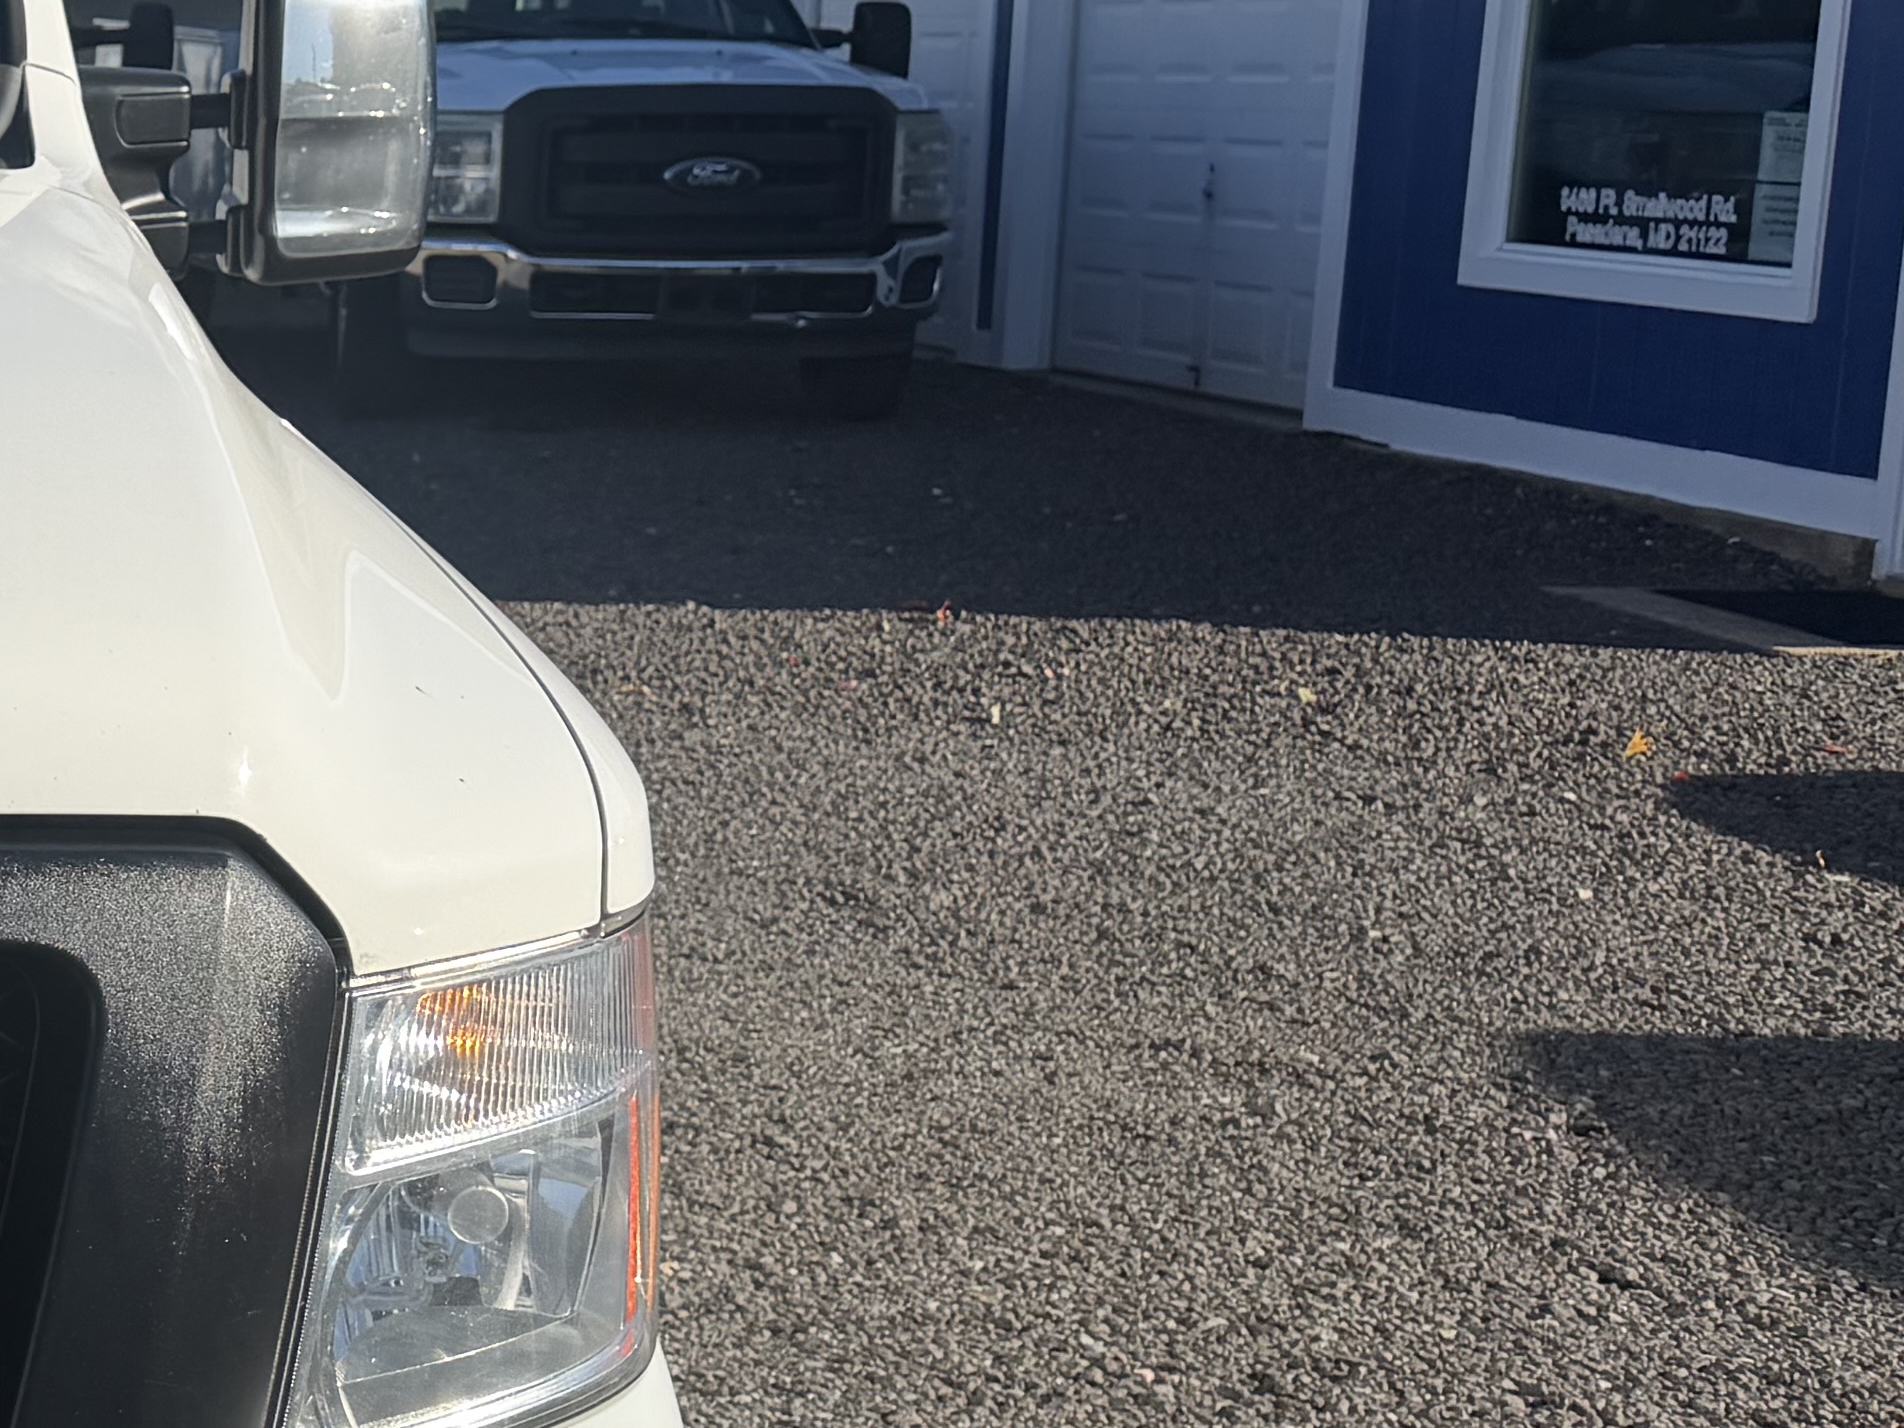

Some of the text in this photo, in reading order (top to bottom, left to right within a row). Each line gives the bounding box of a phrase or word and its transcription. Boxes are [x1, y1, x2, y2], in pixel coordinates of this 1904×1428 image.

[687, 163, 740, 187] Ford
[1622, 189, 1708, 222] Smallwood
[1709, 194, 1738, 224] Rd.
[1646, 222, 1676, 251] MD
[1678, 225, 1729, 255] 21122
